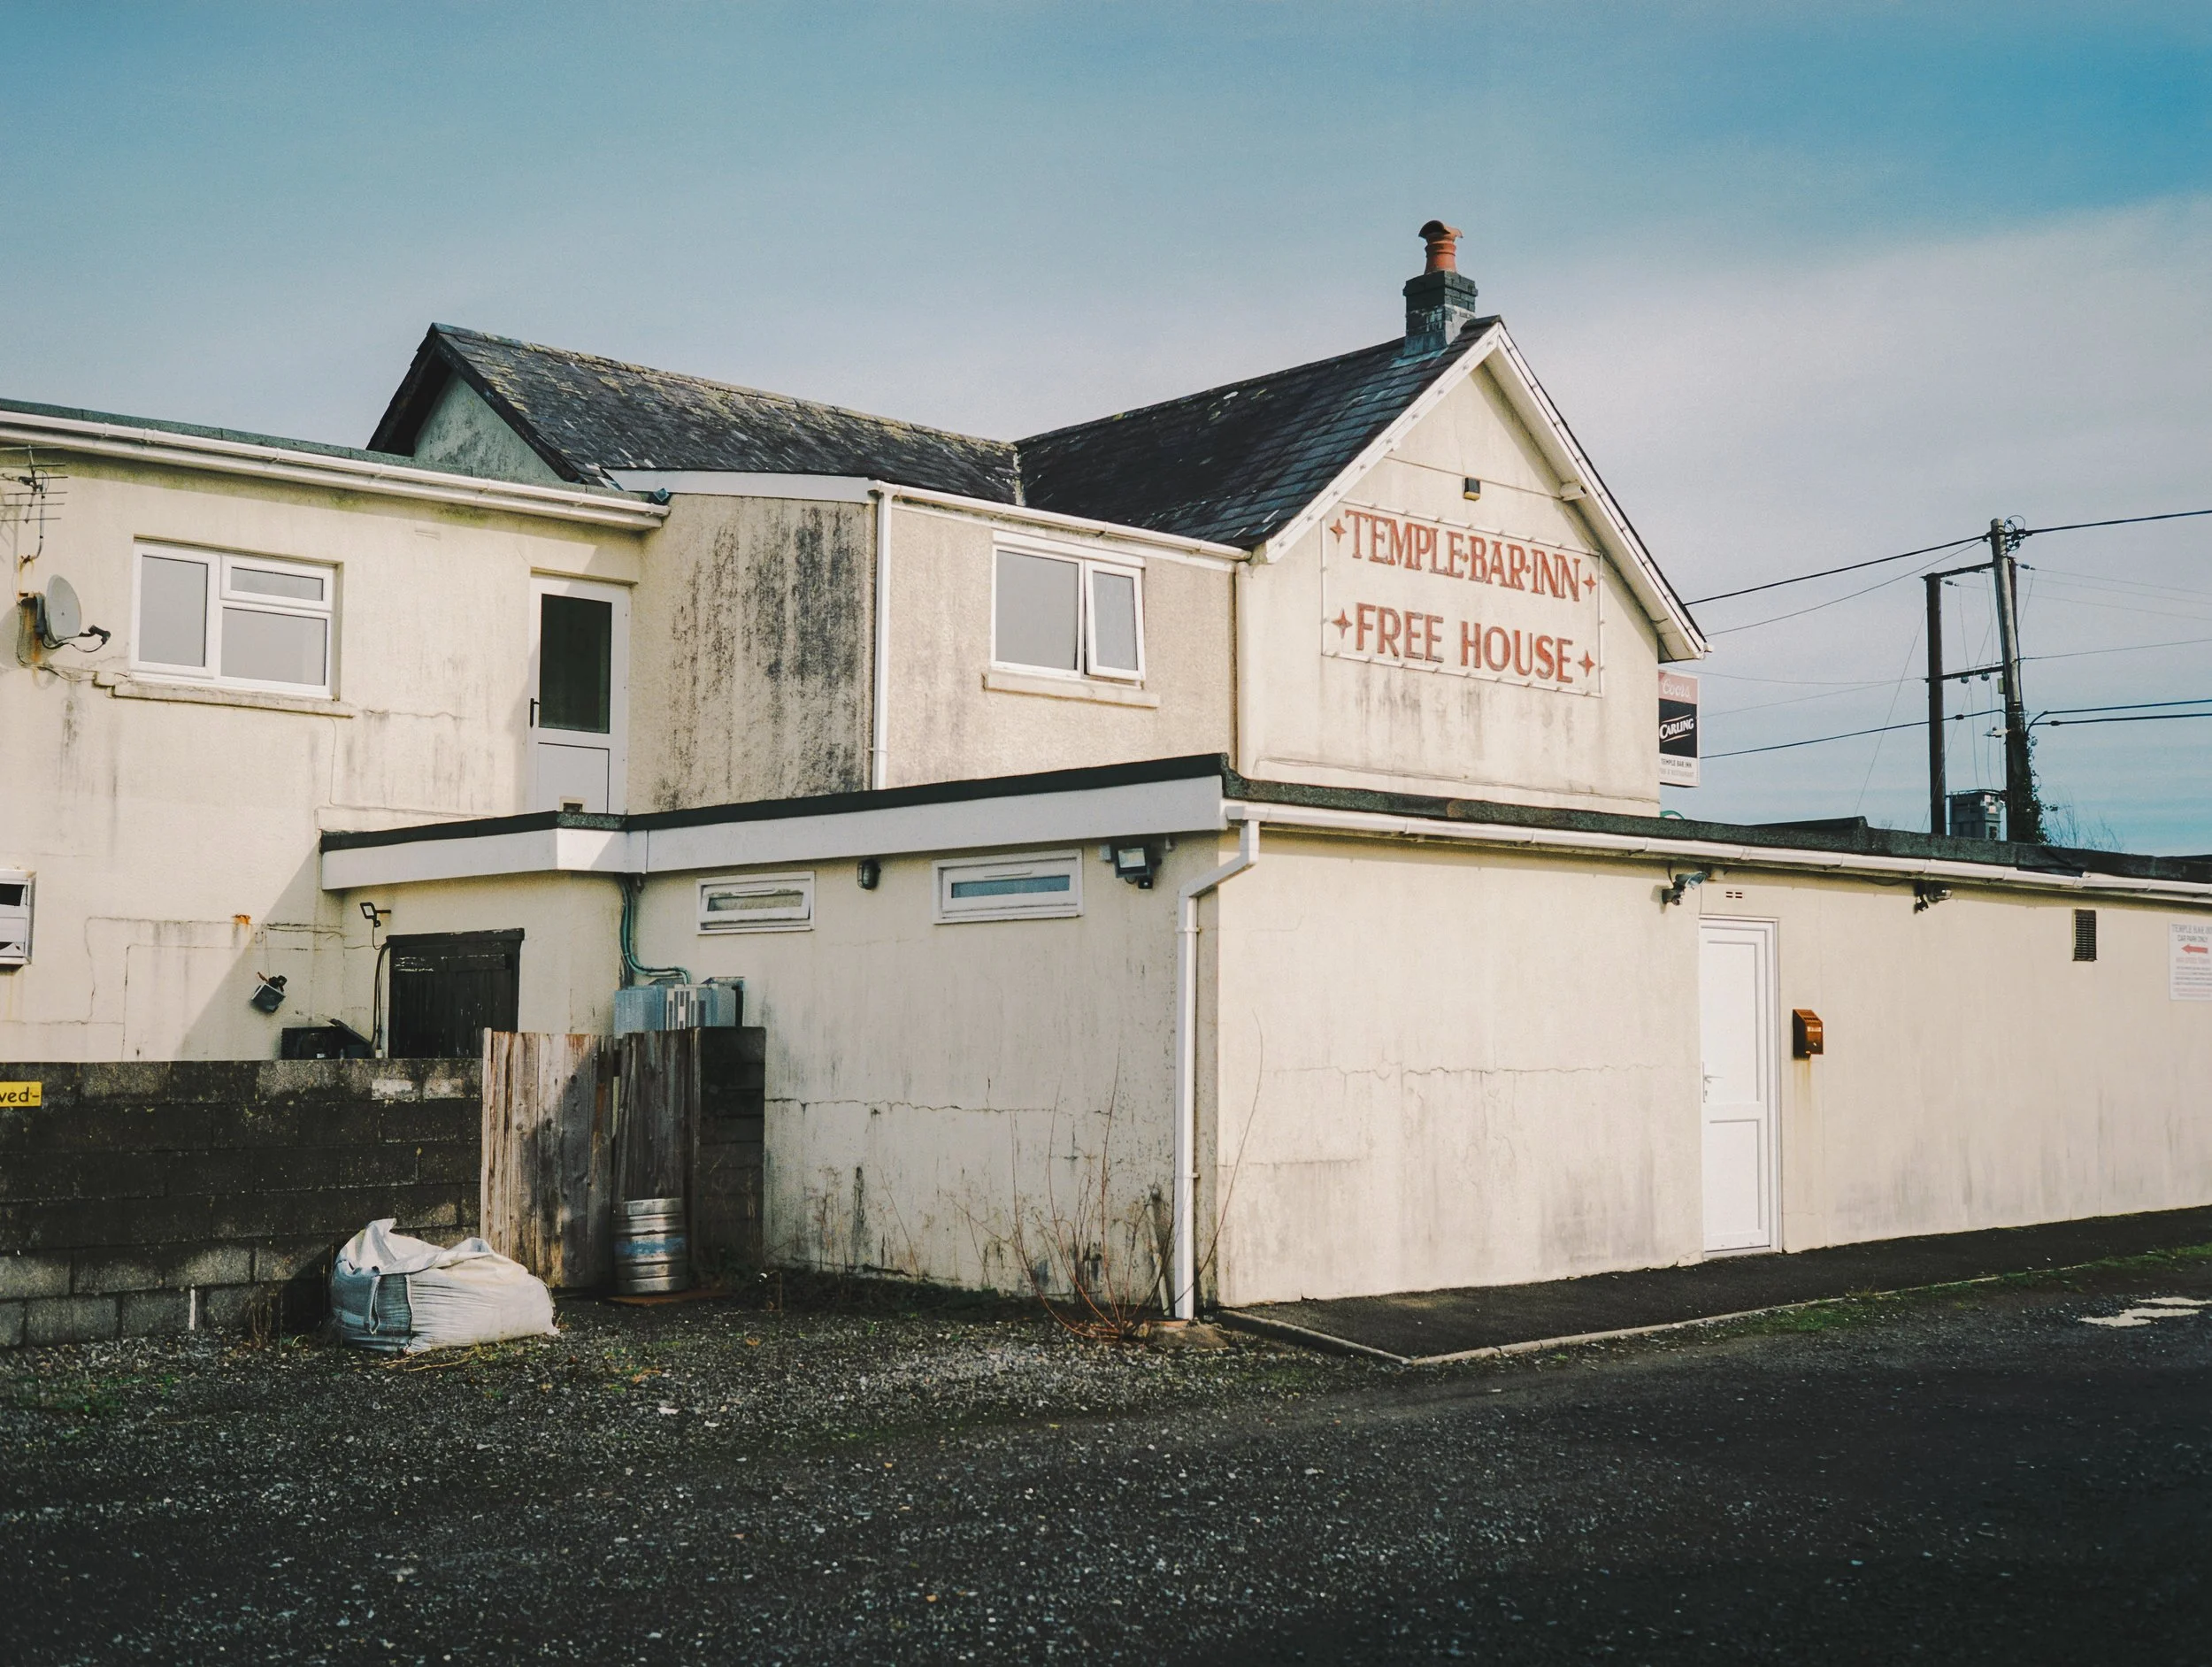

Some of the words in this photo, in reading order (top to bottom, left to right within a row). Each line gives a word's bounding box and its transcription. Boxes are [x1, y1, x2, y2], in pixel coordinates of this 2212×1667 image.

[1356, 603, 1444, 663] FREE
[1460, 620, 1573, 683] HOUSE
[1659, 718, 1694, 740] CARLING
